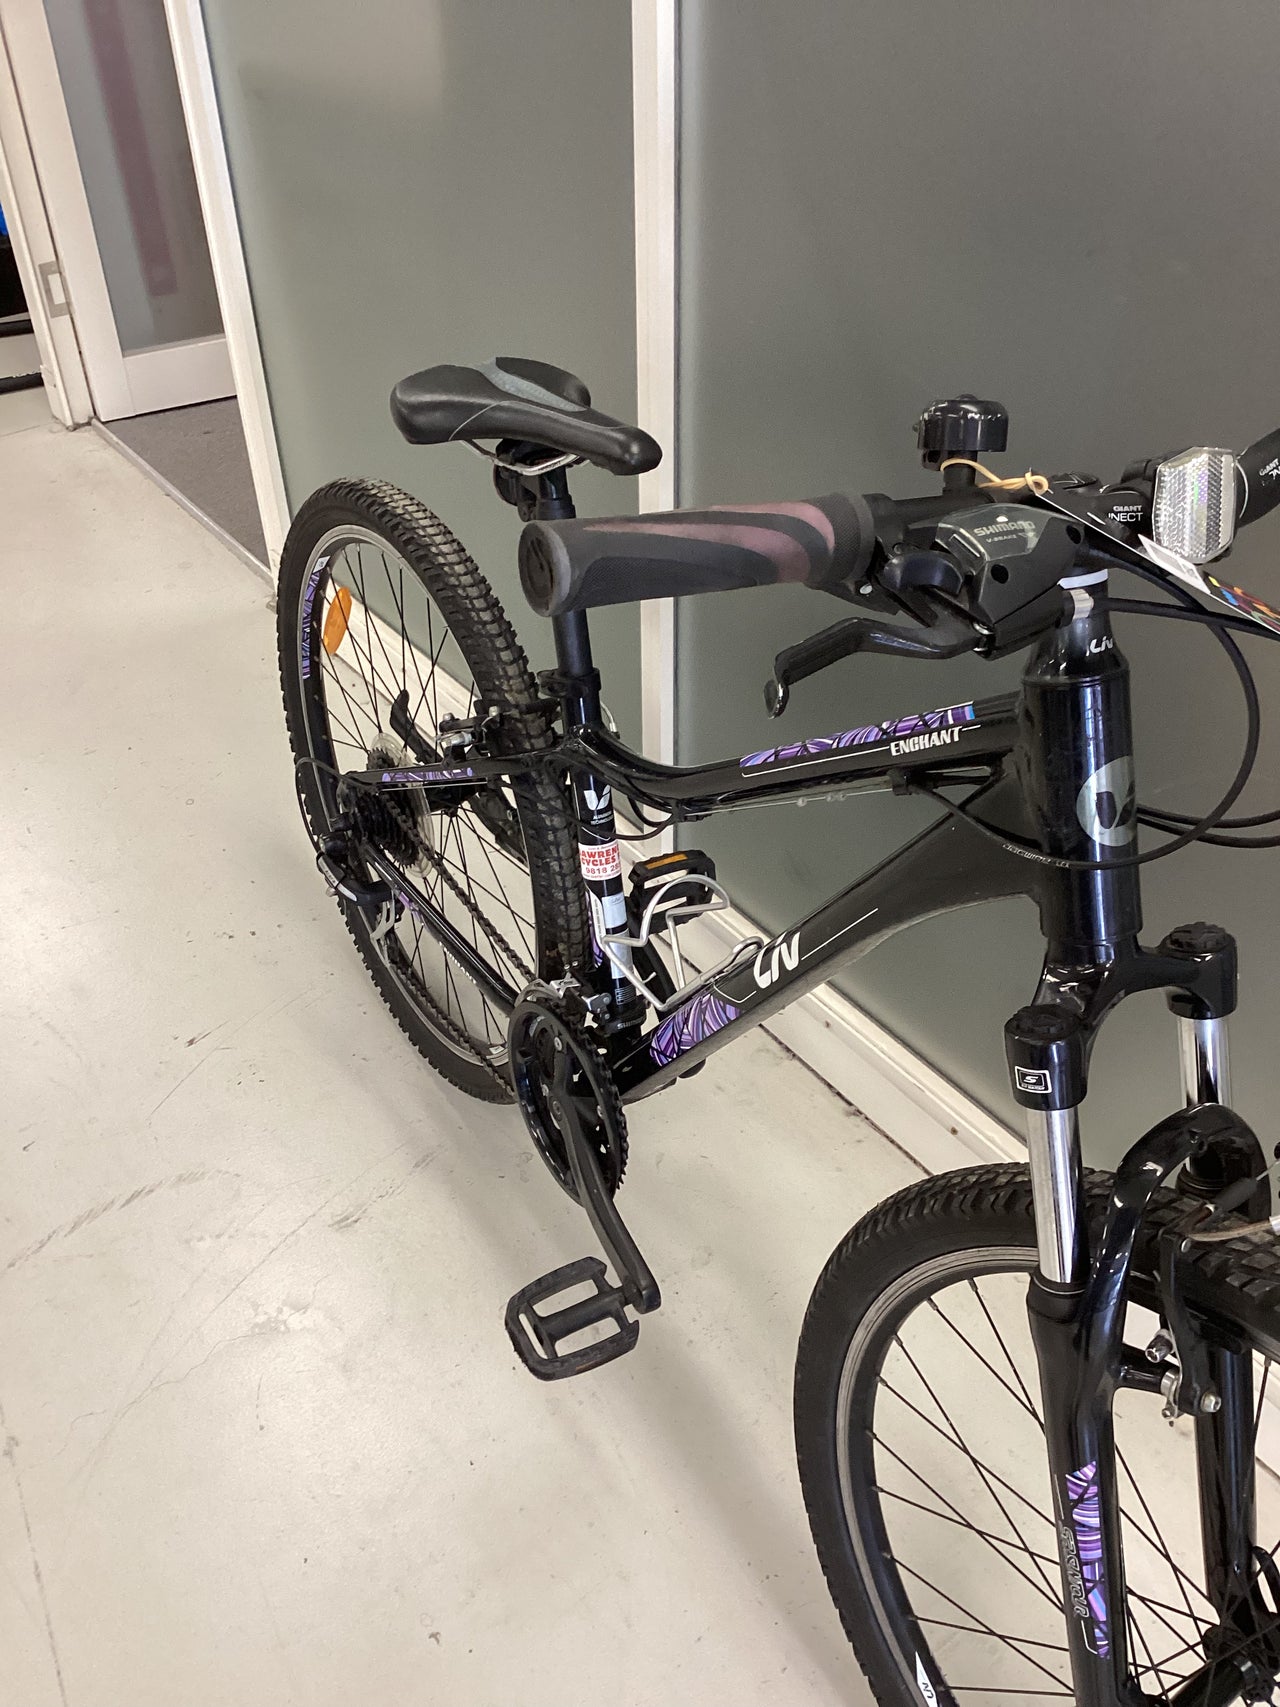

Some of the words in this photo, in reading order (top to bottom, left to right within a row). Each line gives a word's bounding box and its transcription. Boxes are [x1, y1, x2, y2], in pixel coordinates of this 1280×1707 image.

[1108, 512, 1143, 522] NECT
[974, 520, 1036, 537] SHIMANO
[890, 726, 963, 756] ENCHANT
